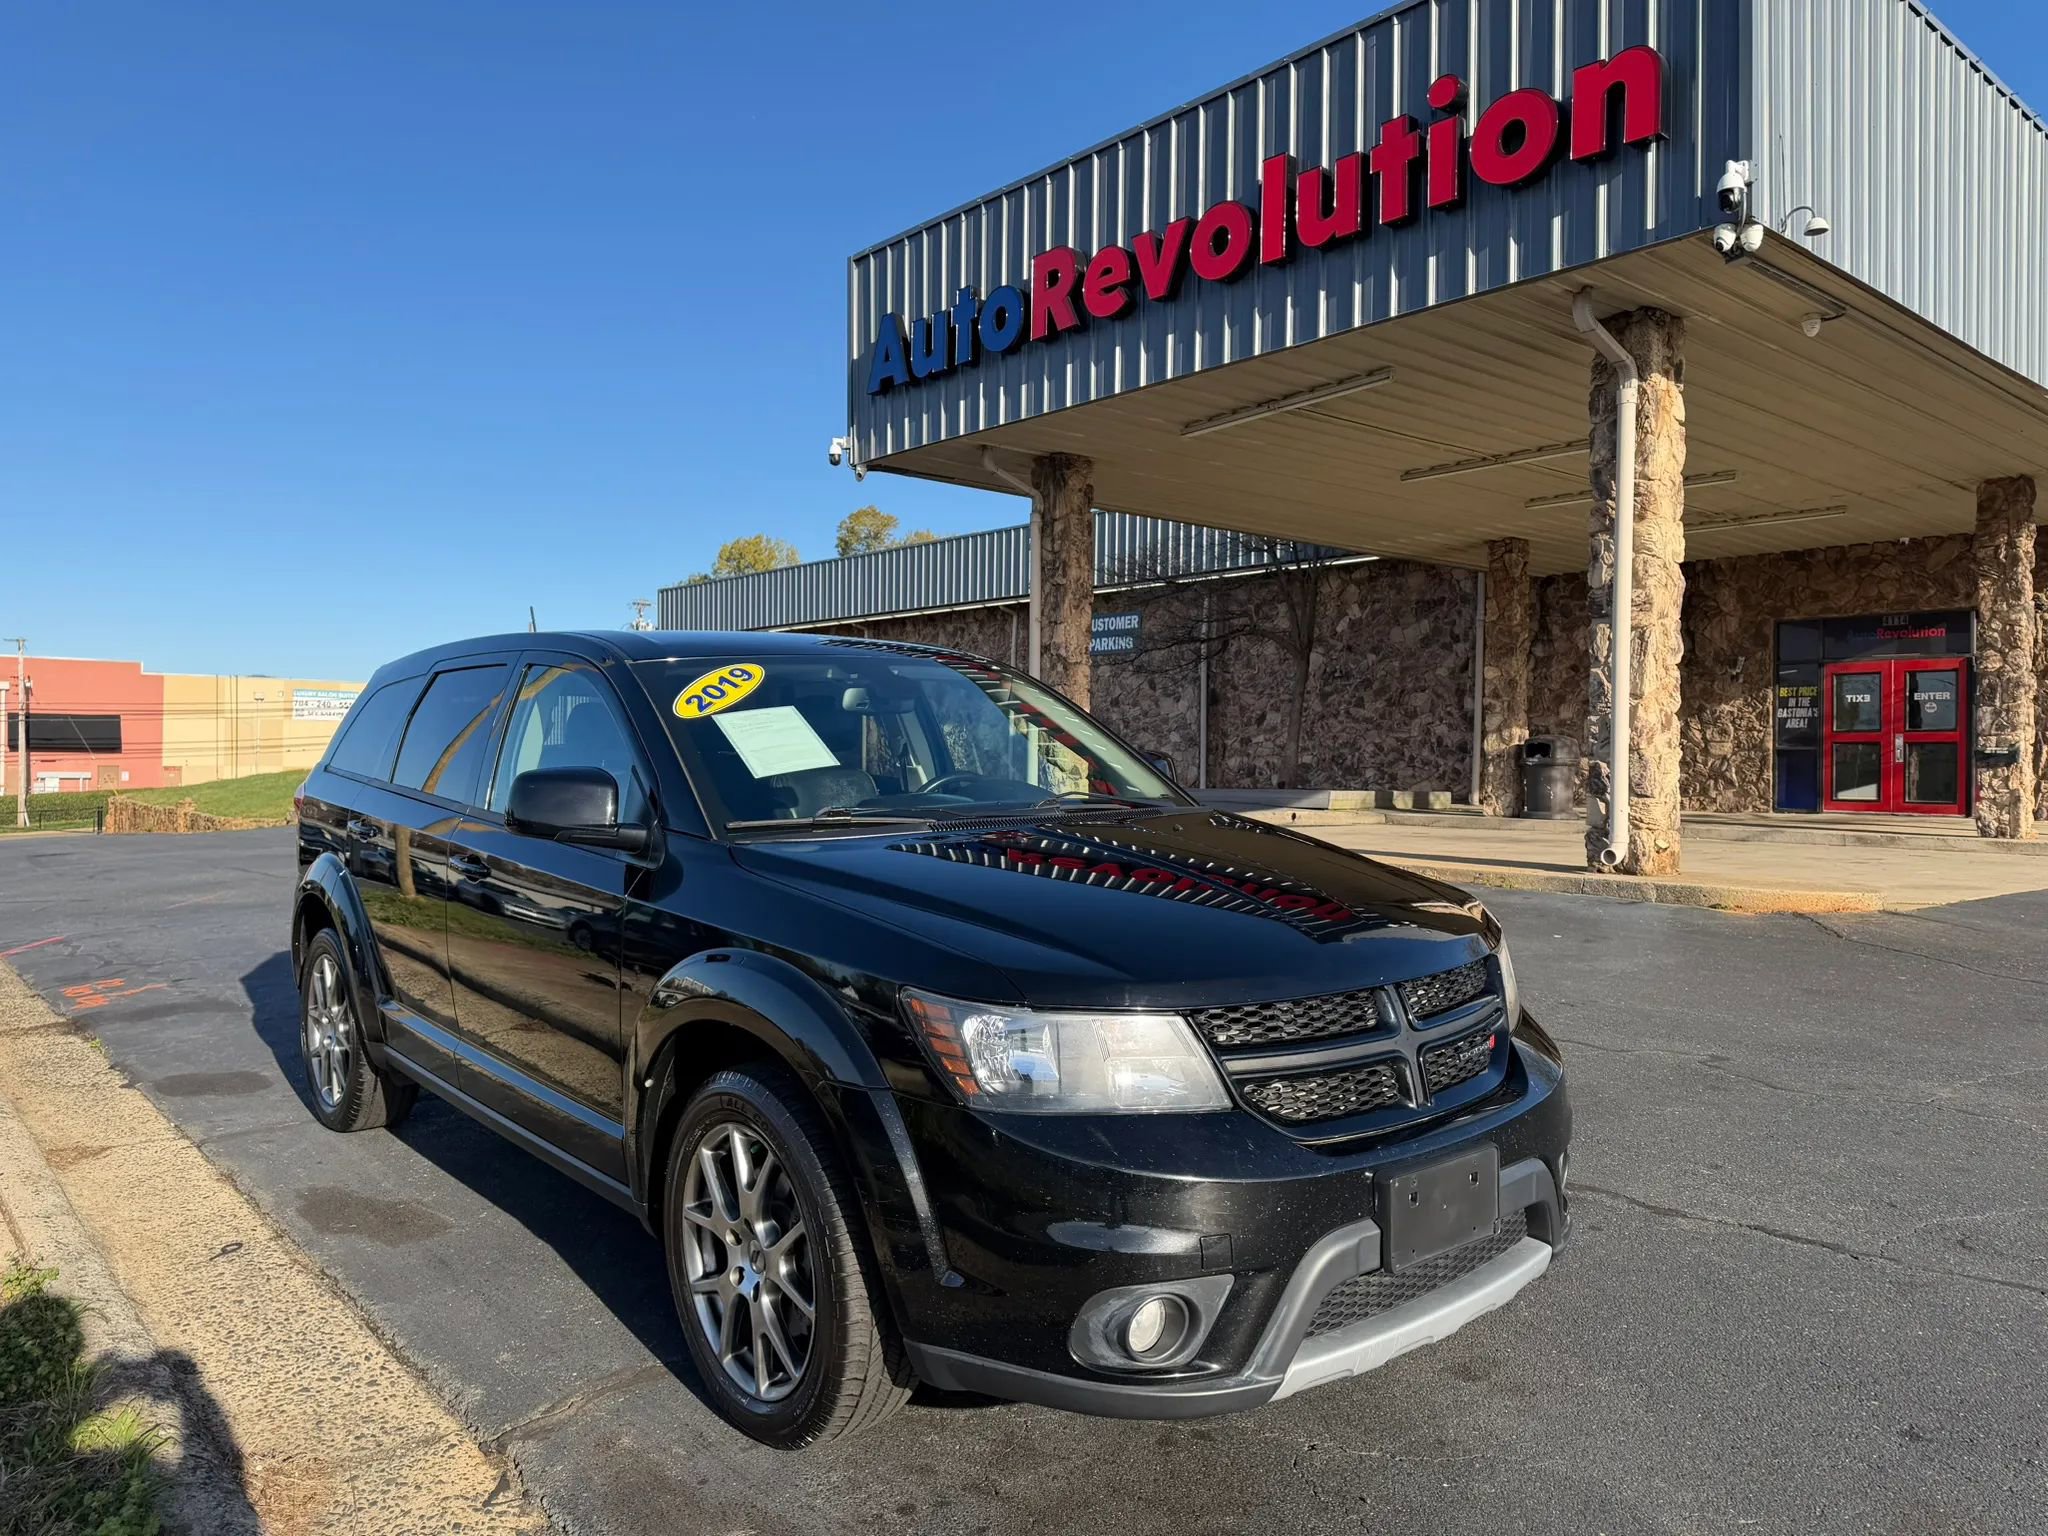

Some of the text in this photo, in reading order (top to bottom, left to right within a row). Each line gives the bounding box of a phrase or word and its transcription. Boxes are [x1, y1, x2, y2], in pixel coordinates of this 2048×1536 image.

[867, 45, 1667, 395] AutoRevolution
[1091, 615, 1140, 632] USTOMER
[1089, 637, 1134, 652] PARKING
[685, 667, 756, 714] 2019
[1779, 686, 1818, 697] BEST PRICE
[1914, 691, 1951, 701] ENTER
[1788, 697, 1811, 707] IN THE
[1785, 718, 1808, 729] AREA!
